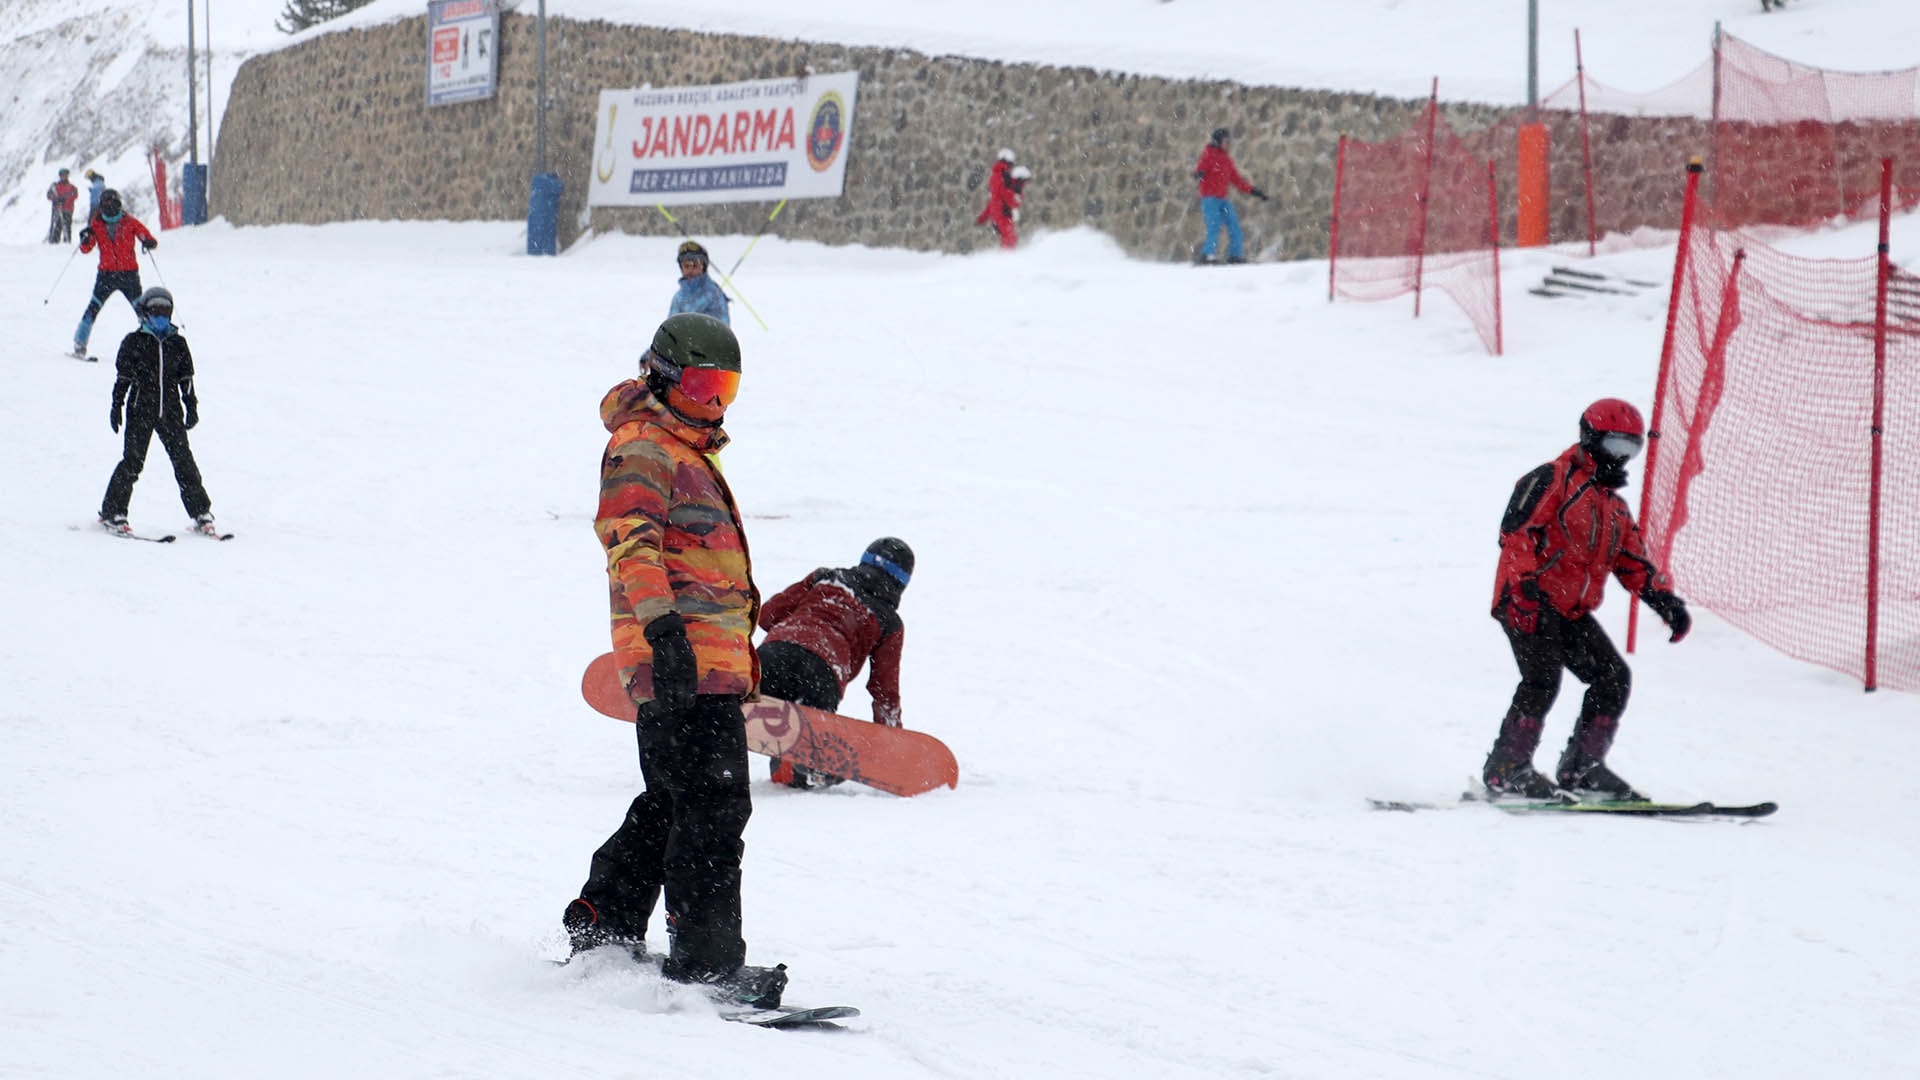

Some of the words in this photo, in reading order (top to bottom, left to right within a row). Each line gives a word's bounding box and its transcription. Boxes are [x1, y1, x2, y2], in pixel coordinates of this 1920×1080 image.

[632, 107, 796, 159] JANDARMA
[633, 171, 659, 190] HER
[662, 169, 707, 189] ZAMAN
[712, 166, 785, 187] YANINIZDA
